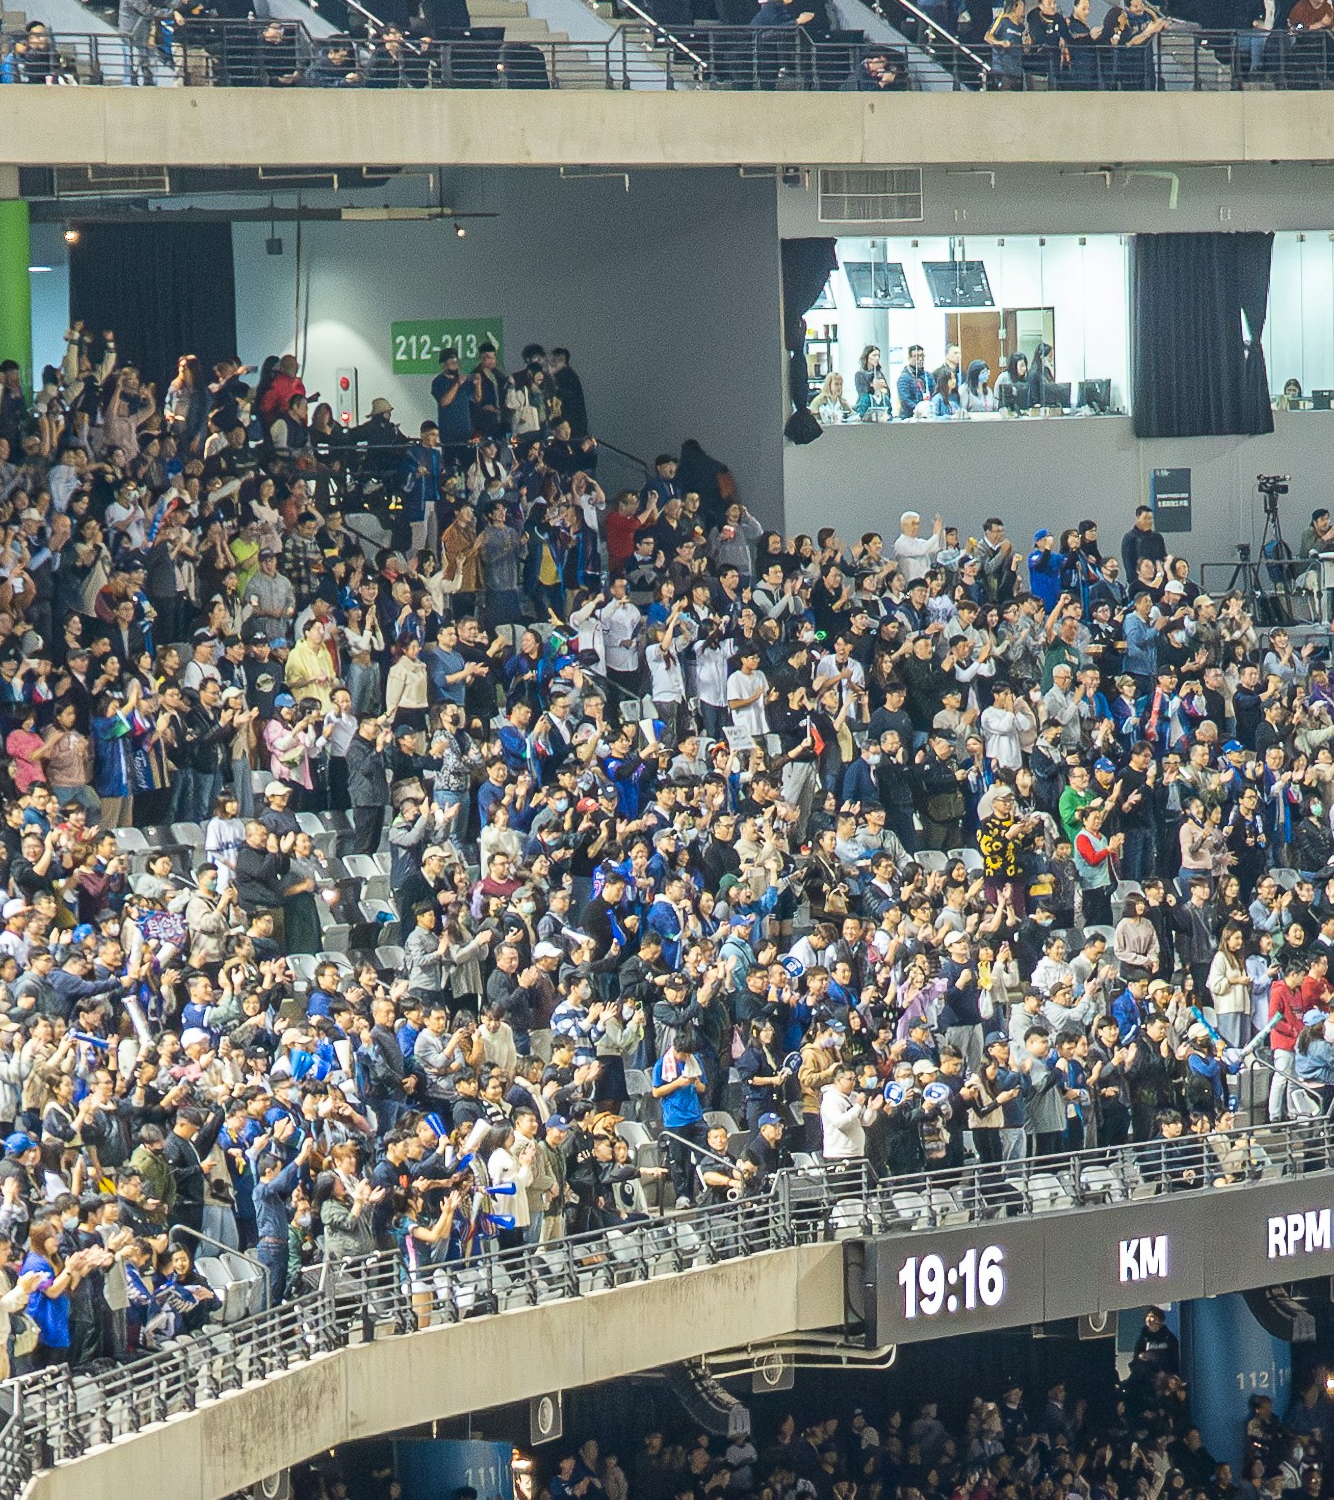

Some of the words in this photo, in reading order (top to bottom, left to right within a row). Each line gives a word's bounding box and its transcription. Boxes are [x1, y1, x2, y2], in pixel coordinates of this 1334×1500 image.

[1118, 1234, 1169, 1283] KM
[1267, 1208, 1332, 1260] RPM
[897, 1245, 1006, 1319] 19:16
[1236, 1370, 1269, 1390] 112
